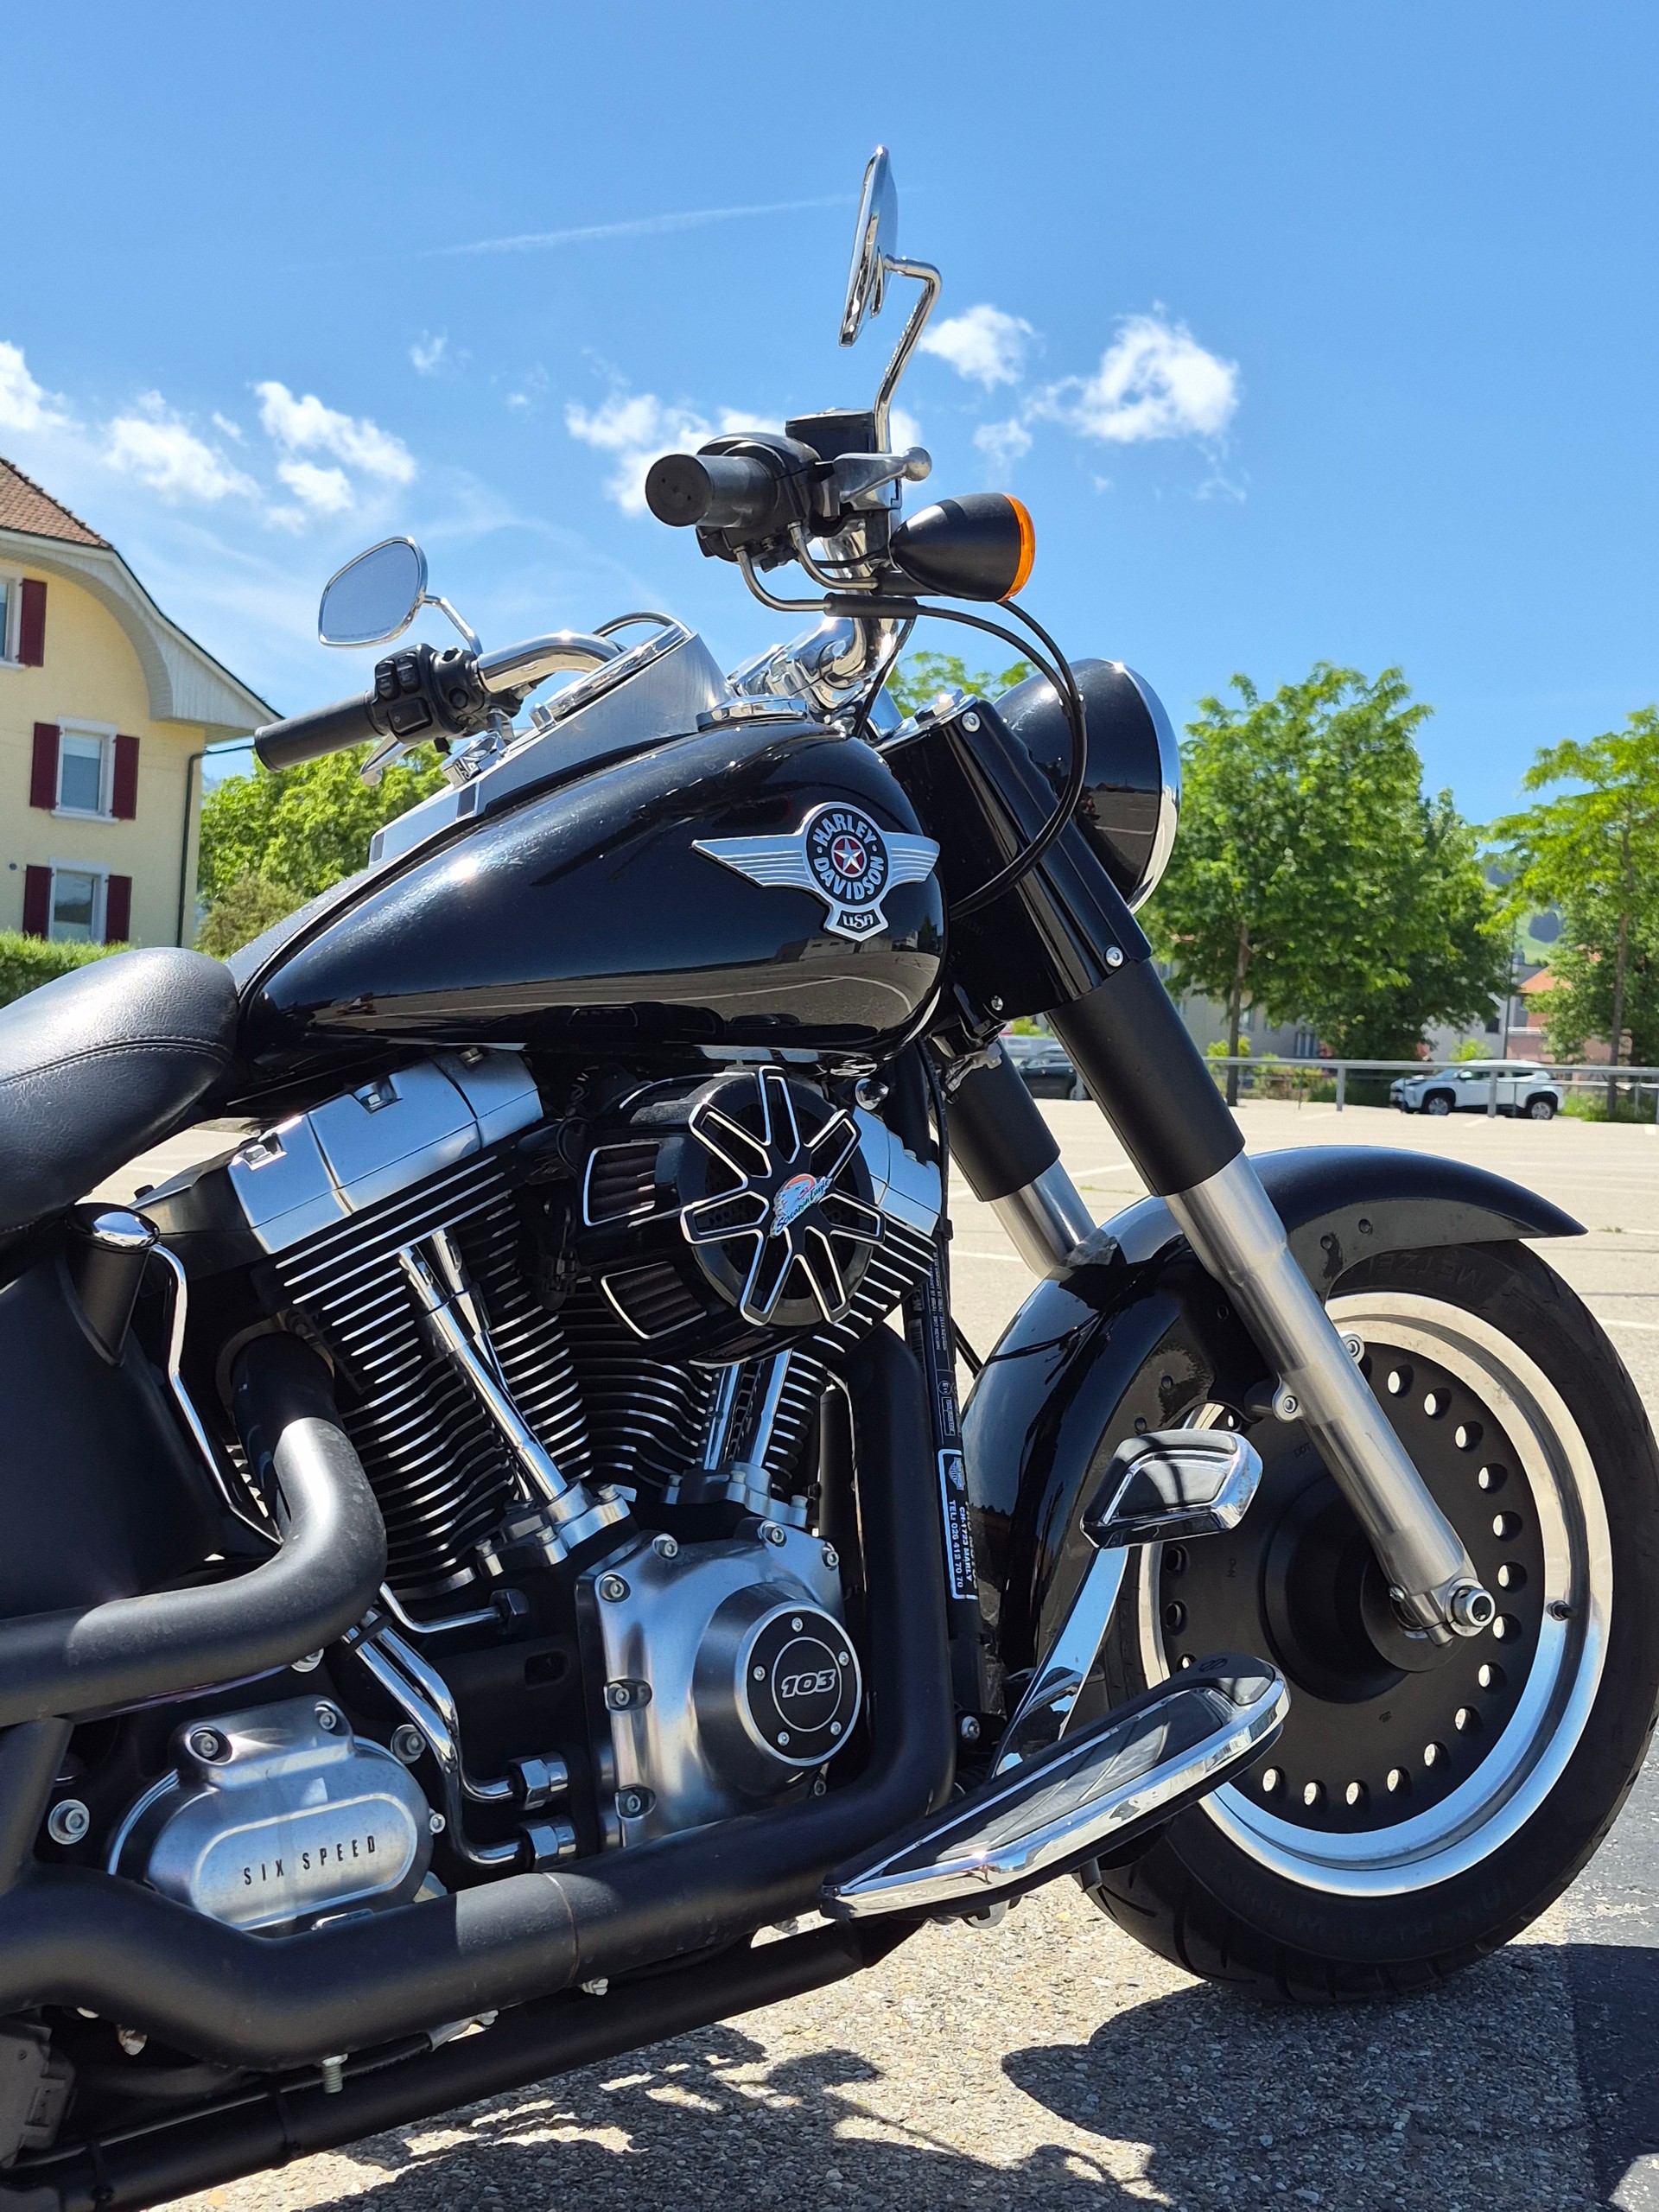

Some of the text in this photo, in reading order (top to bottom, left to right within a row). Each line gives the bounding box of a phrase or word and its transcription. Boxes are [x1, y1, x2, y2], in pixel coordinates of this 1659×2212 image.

[813, 814, 877, 847] HARLEY
[814, 855, 884, 900] DAVIDSON
[842, 913, 874, 929] USA
[781, 1669, 836, 1698] 103
[244, 1835, 375, 1885] SIX SPEED
